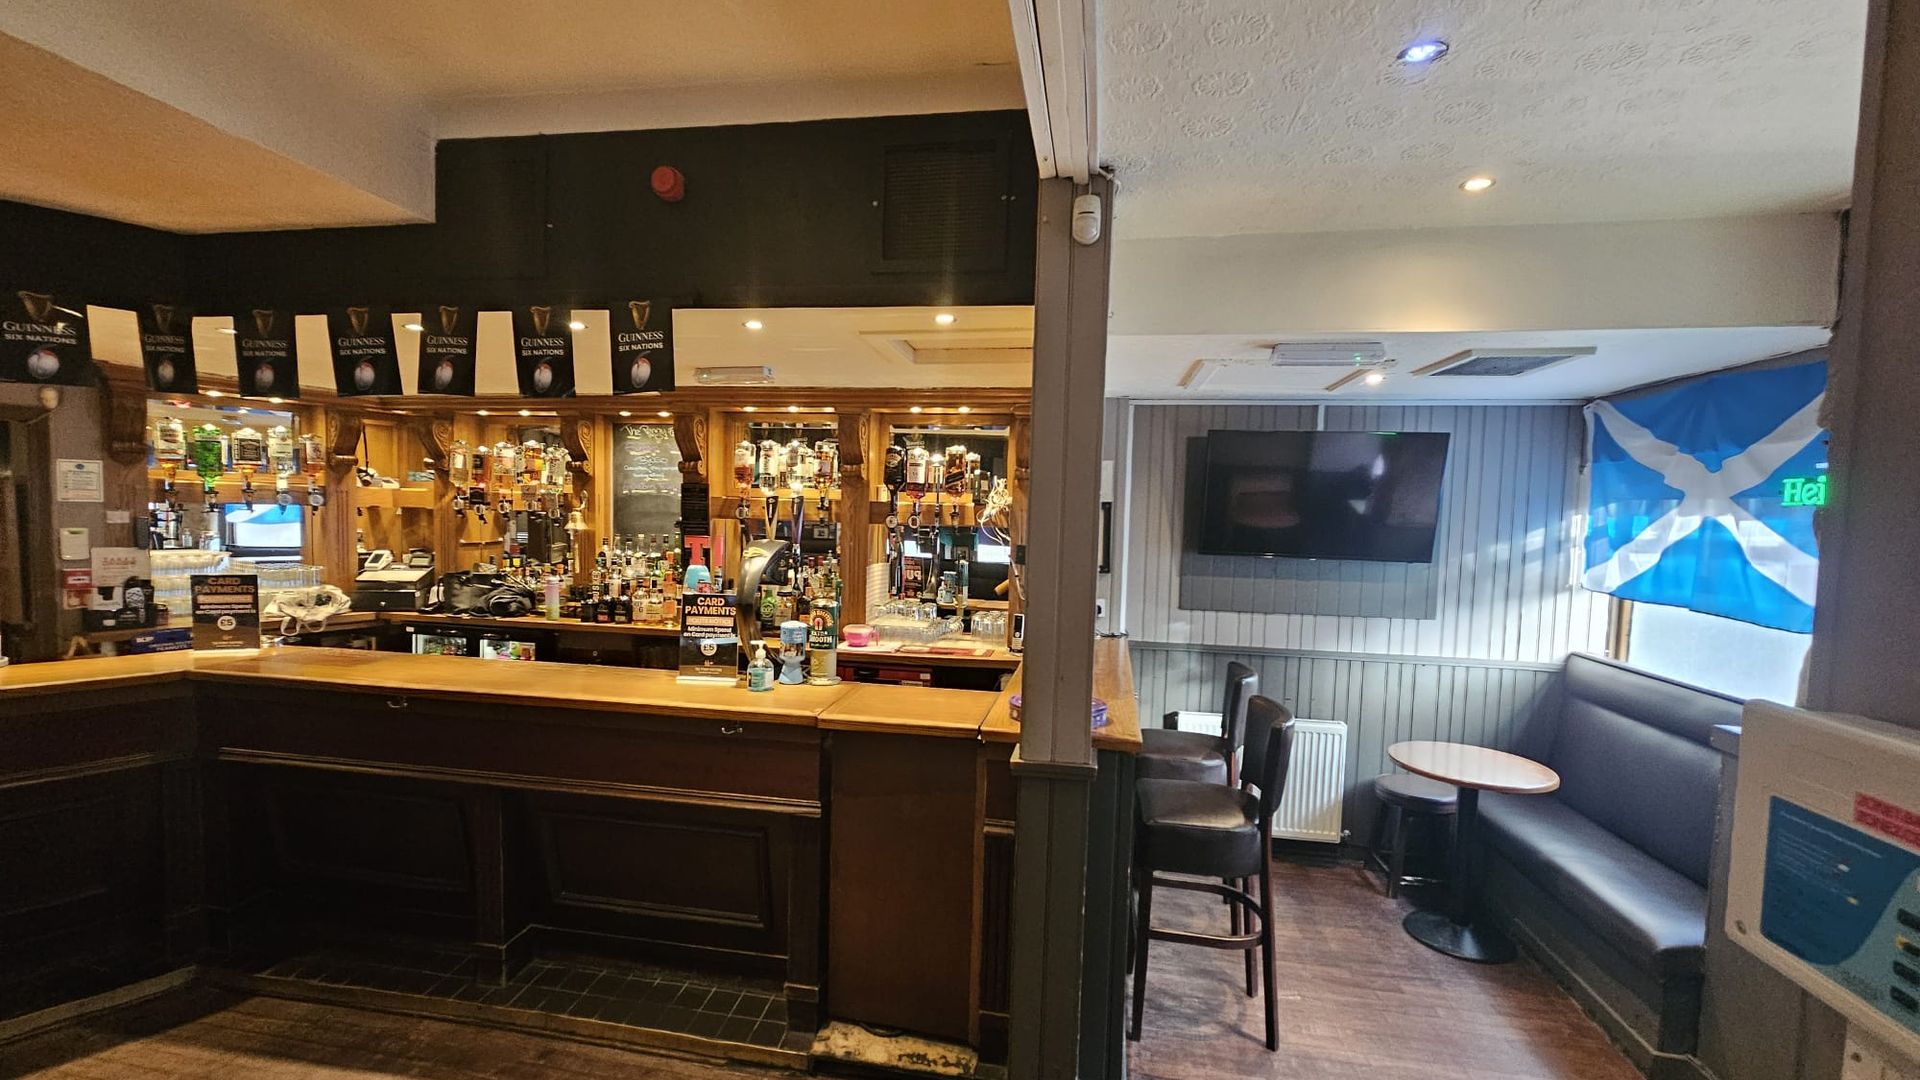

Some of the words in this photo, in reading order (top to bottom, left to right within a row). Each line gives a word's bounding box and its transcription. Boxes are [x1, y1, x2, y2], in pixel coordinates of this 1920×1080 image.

[2, 321, 77, 336] GUINNESS
[4, 333, 23, 341] SIX
[25, 335, 78, 345] NATIONS
[338, 336, 386, 347] GUINNESS
[426, 335, 468, 346] GUINNESS
[520, 336, 565, 347] GUINNESS
[618, 330, 664, 343] GUINNESS
[241, 338, 287, 349] GUINNESS
[618, 344, 630, 352] SIX
[631, 342, 664, 350] NATIONS
[352, 347, 386, 355] NATIONS
[438, 347, 468, 355] NATIONS
[521, 349, 532, 357] SIX
[533, 348, 565, 356] NATIONS
[208, 577, 241, 585] CARD
[194, 585, 256, 594] PAYMENTS
[697, 596, 725, 607] CARD
[685, 605, 737, 616] PAYMENTS
[704, 643, 715, 651] £5
